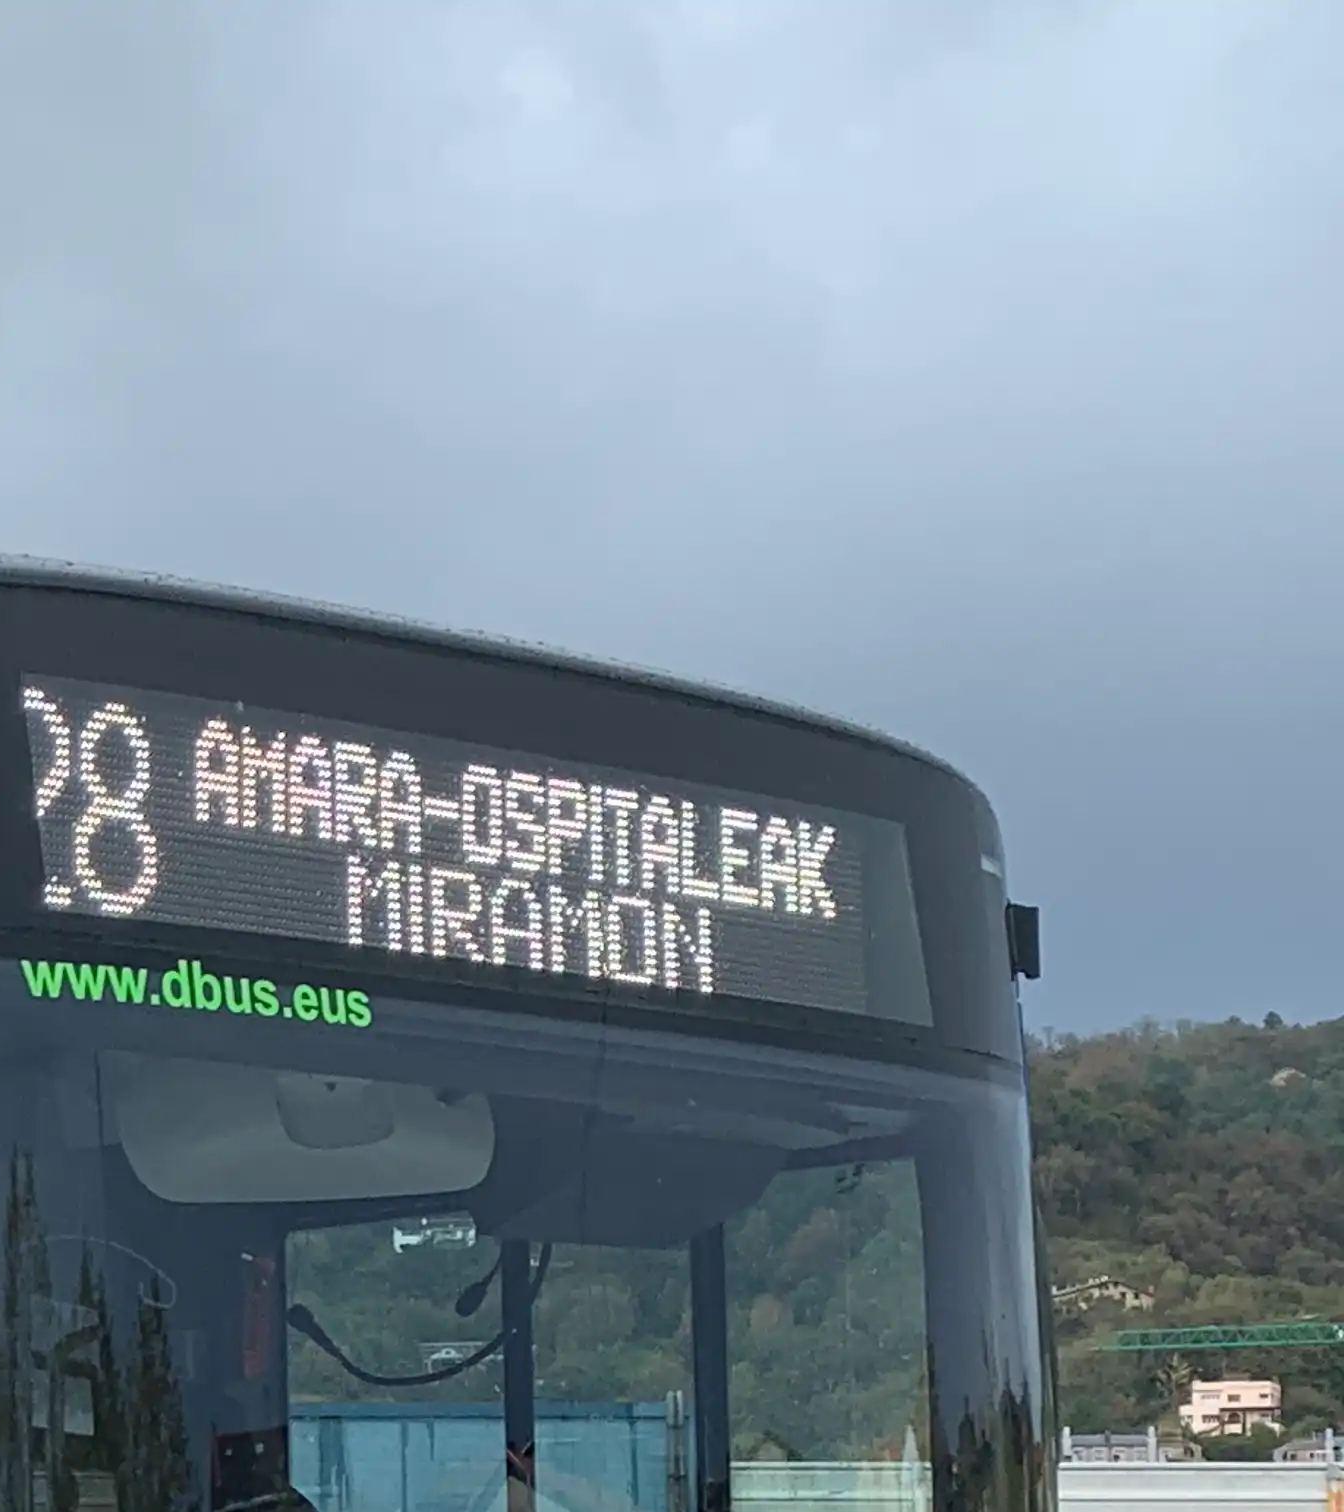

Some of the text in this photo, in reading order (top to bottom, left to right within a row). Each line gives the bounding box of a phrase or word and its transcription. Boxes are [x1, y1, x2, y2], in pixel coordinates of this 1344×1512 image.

[195, 719, 839, 920] AMARA-OSPITALEAK
[21, 959, 373, 1029] www.dbus.eus
[347, 854, 714, 994] MIRAMON
